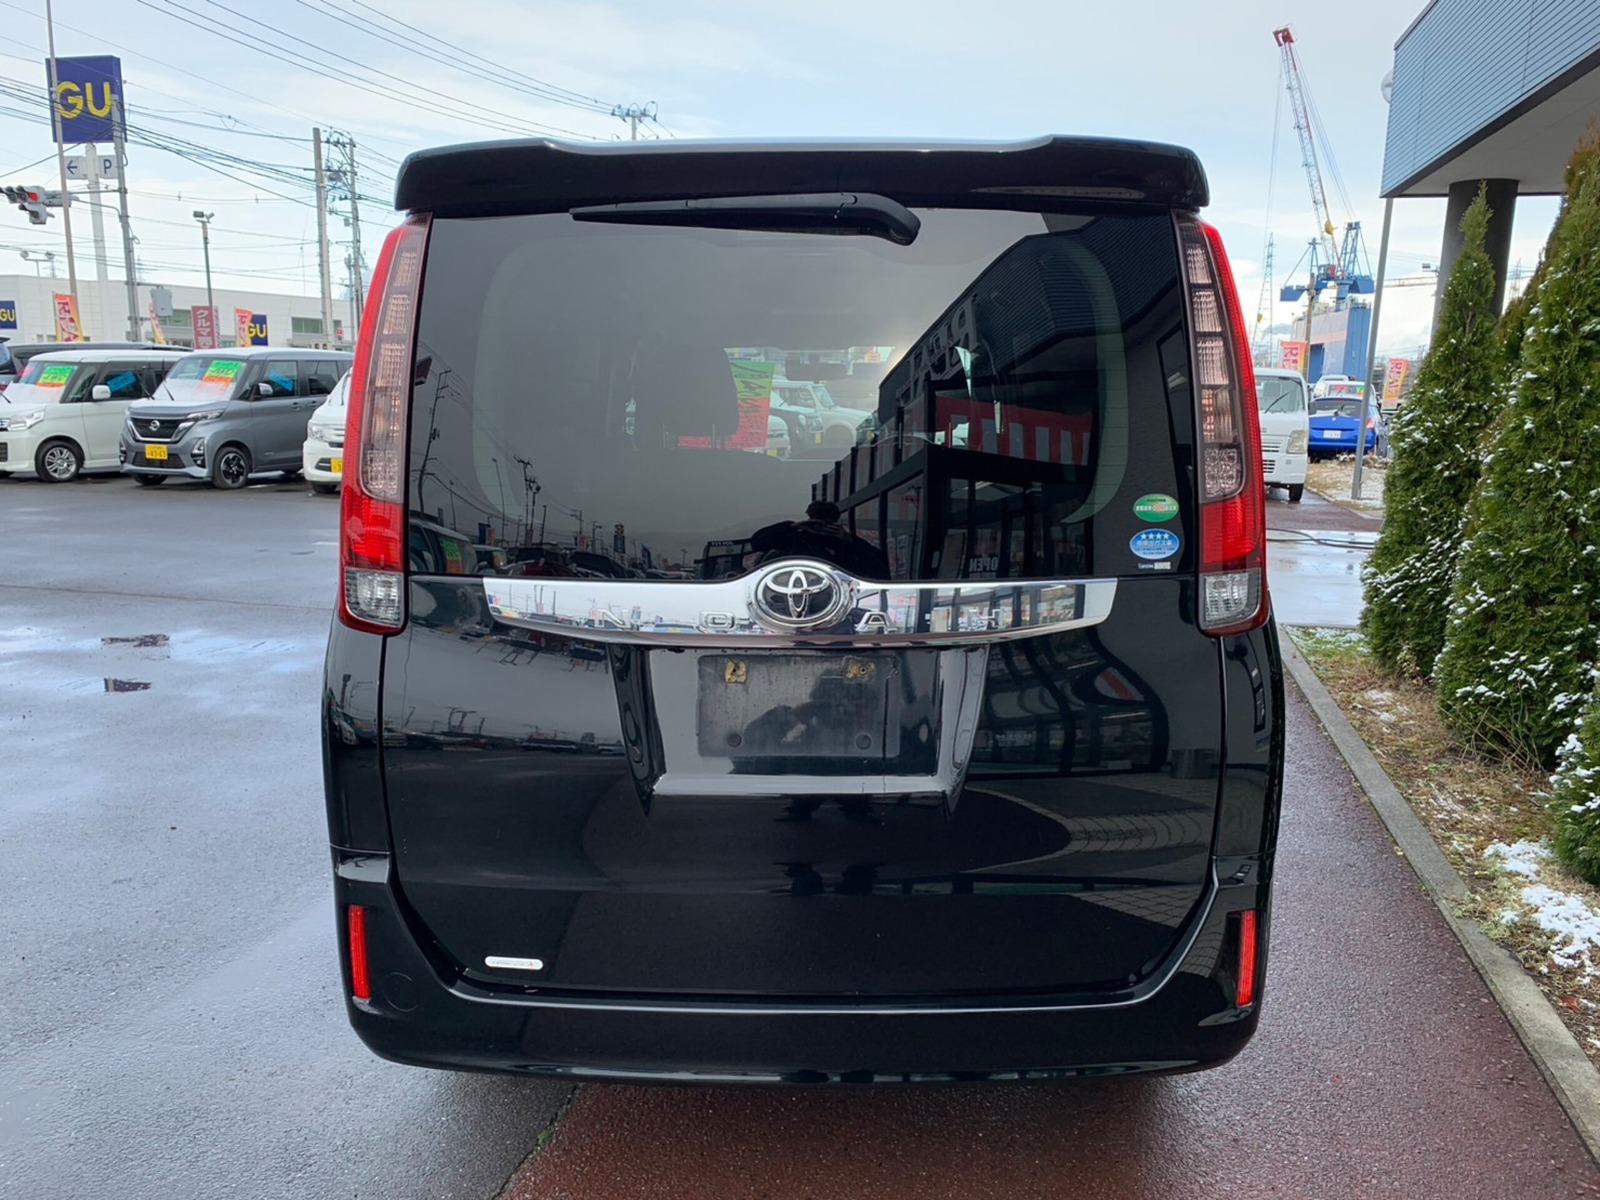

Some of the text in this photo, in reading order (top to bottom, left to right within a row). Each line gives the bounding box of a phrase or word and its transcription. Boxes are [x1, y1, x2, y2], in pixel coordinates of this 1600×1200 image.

[56, 81, 111, 119] GU
[103, 159, 112, 174] P
[0, 308, 15, 322] GU
[248, 323, 267, 338] GU
